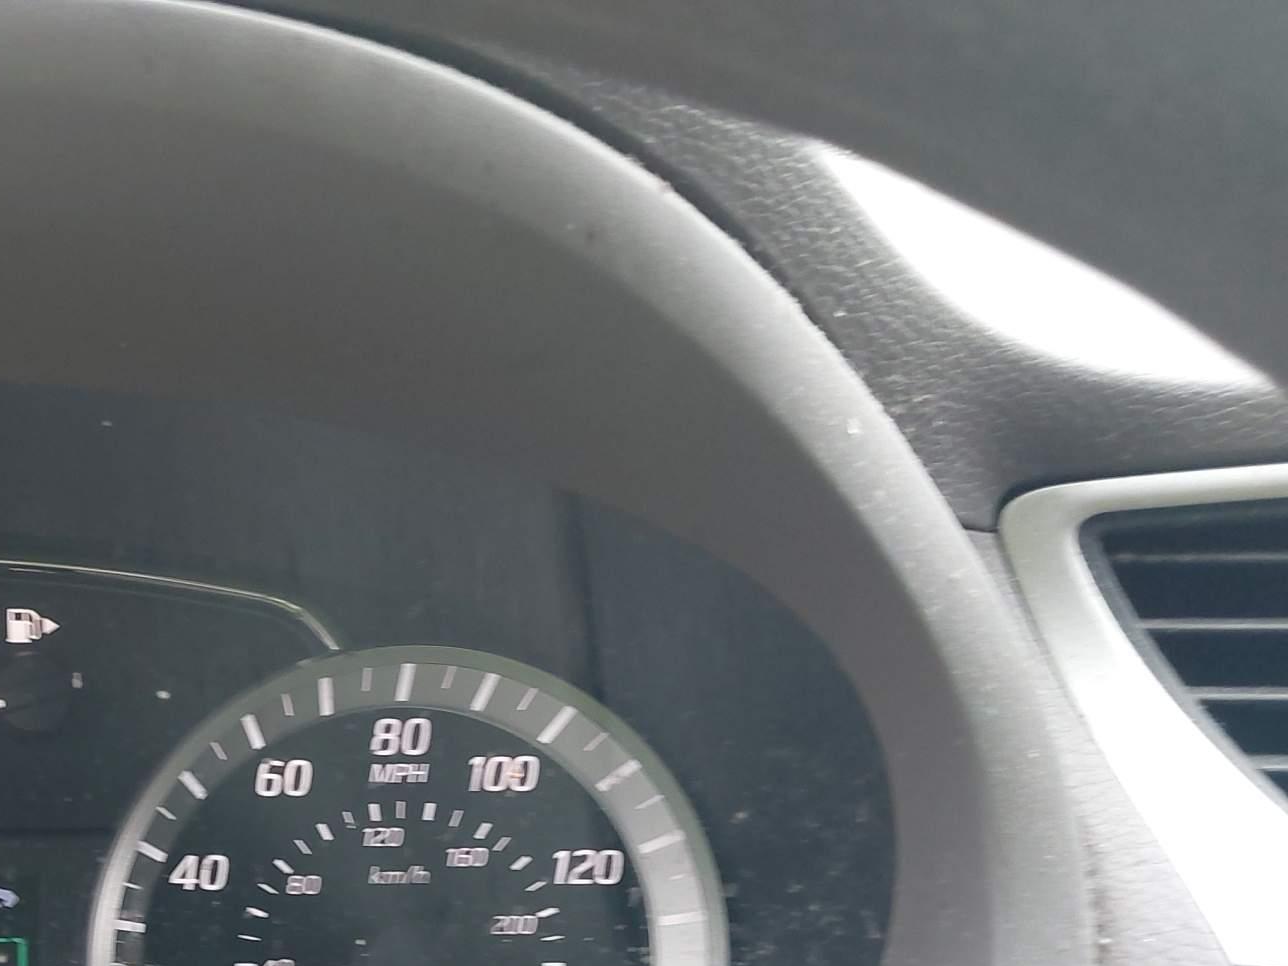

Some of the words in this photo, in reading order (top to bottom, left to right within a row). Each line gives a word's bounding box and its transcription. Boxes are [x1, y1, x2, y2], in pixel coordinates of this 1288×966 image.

[369, 718, 432, 756] 80
[254, 760, 314, 797] 60
[368, 763, 430, 784] MPH
[467, 757, 541, 793] 100
[362, 827, 405, 847] 120
[445, 847, 490, 867] 160
[551, 849, 626, 886] 120
[167, 854, 230, 892] 40
[368, 865, 432, 884] km/h
[285, 875, 322, 895] 80
[489, 915, 539, 935] 200
